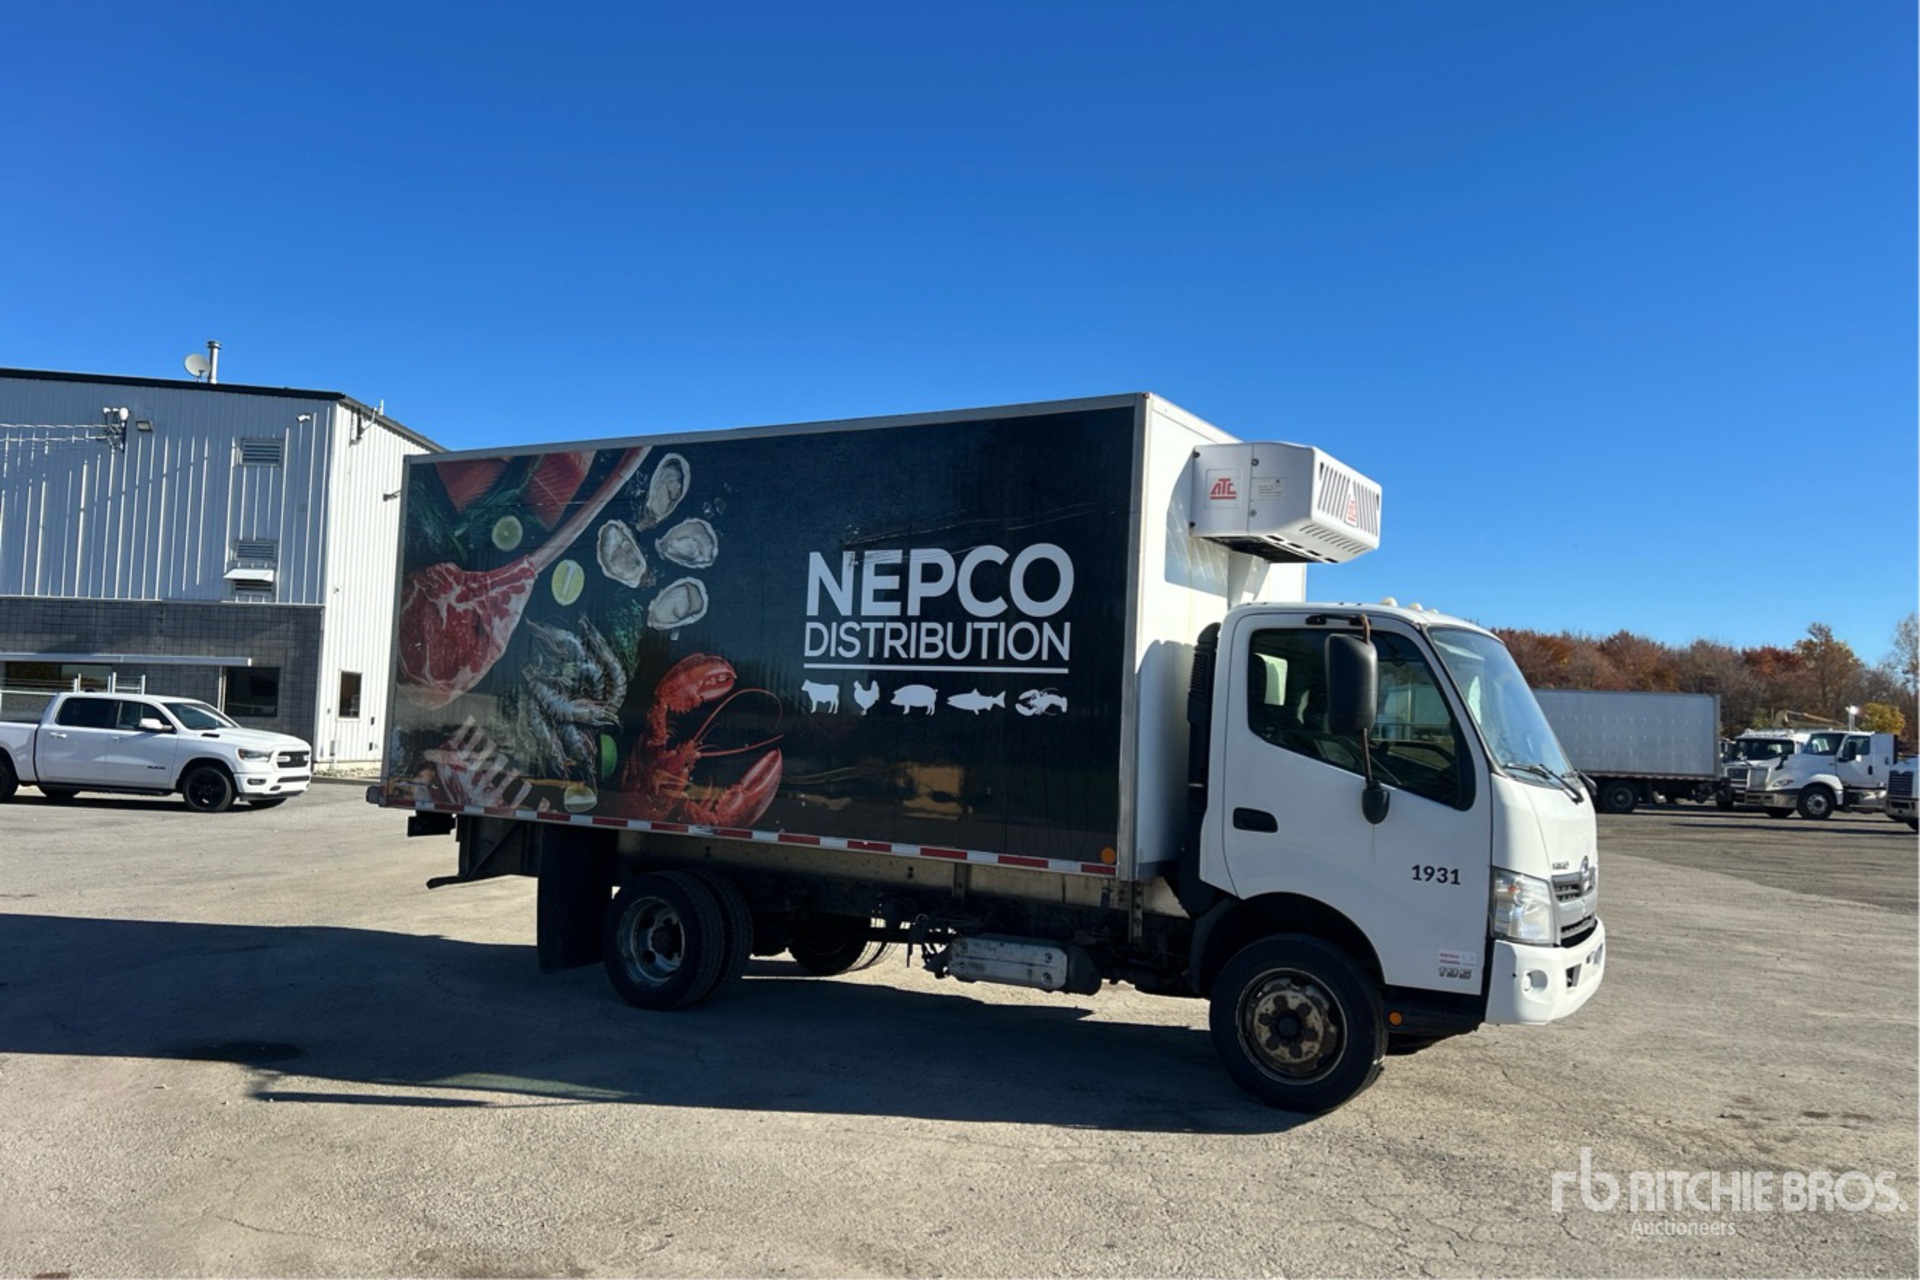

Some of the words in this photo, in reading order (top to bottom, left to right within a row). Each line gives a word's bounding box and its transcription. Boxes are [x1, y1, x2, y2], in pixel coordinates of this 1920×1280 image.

[1210, 477, 1237, 496] ATC
[806, 542, 1075, 618] NEPCO
[803, 621, 1071, 661] DISTRIBUTION
[1411, 864, 1461, 885] 1931
